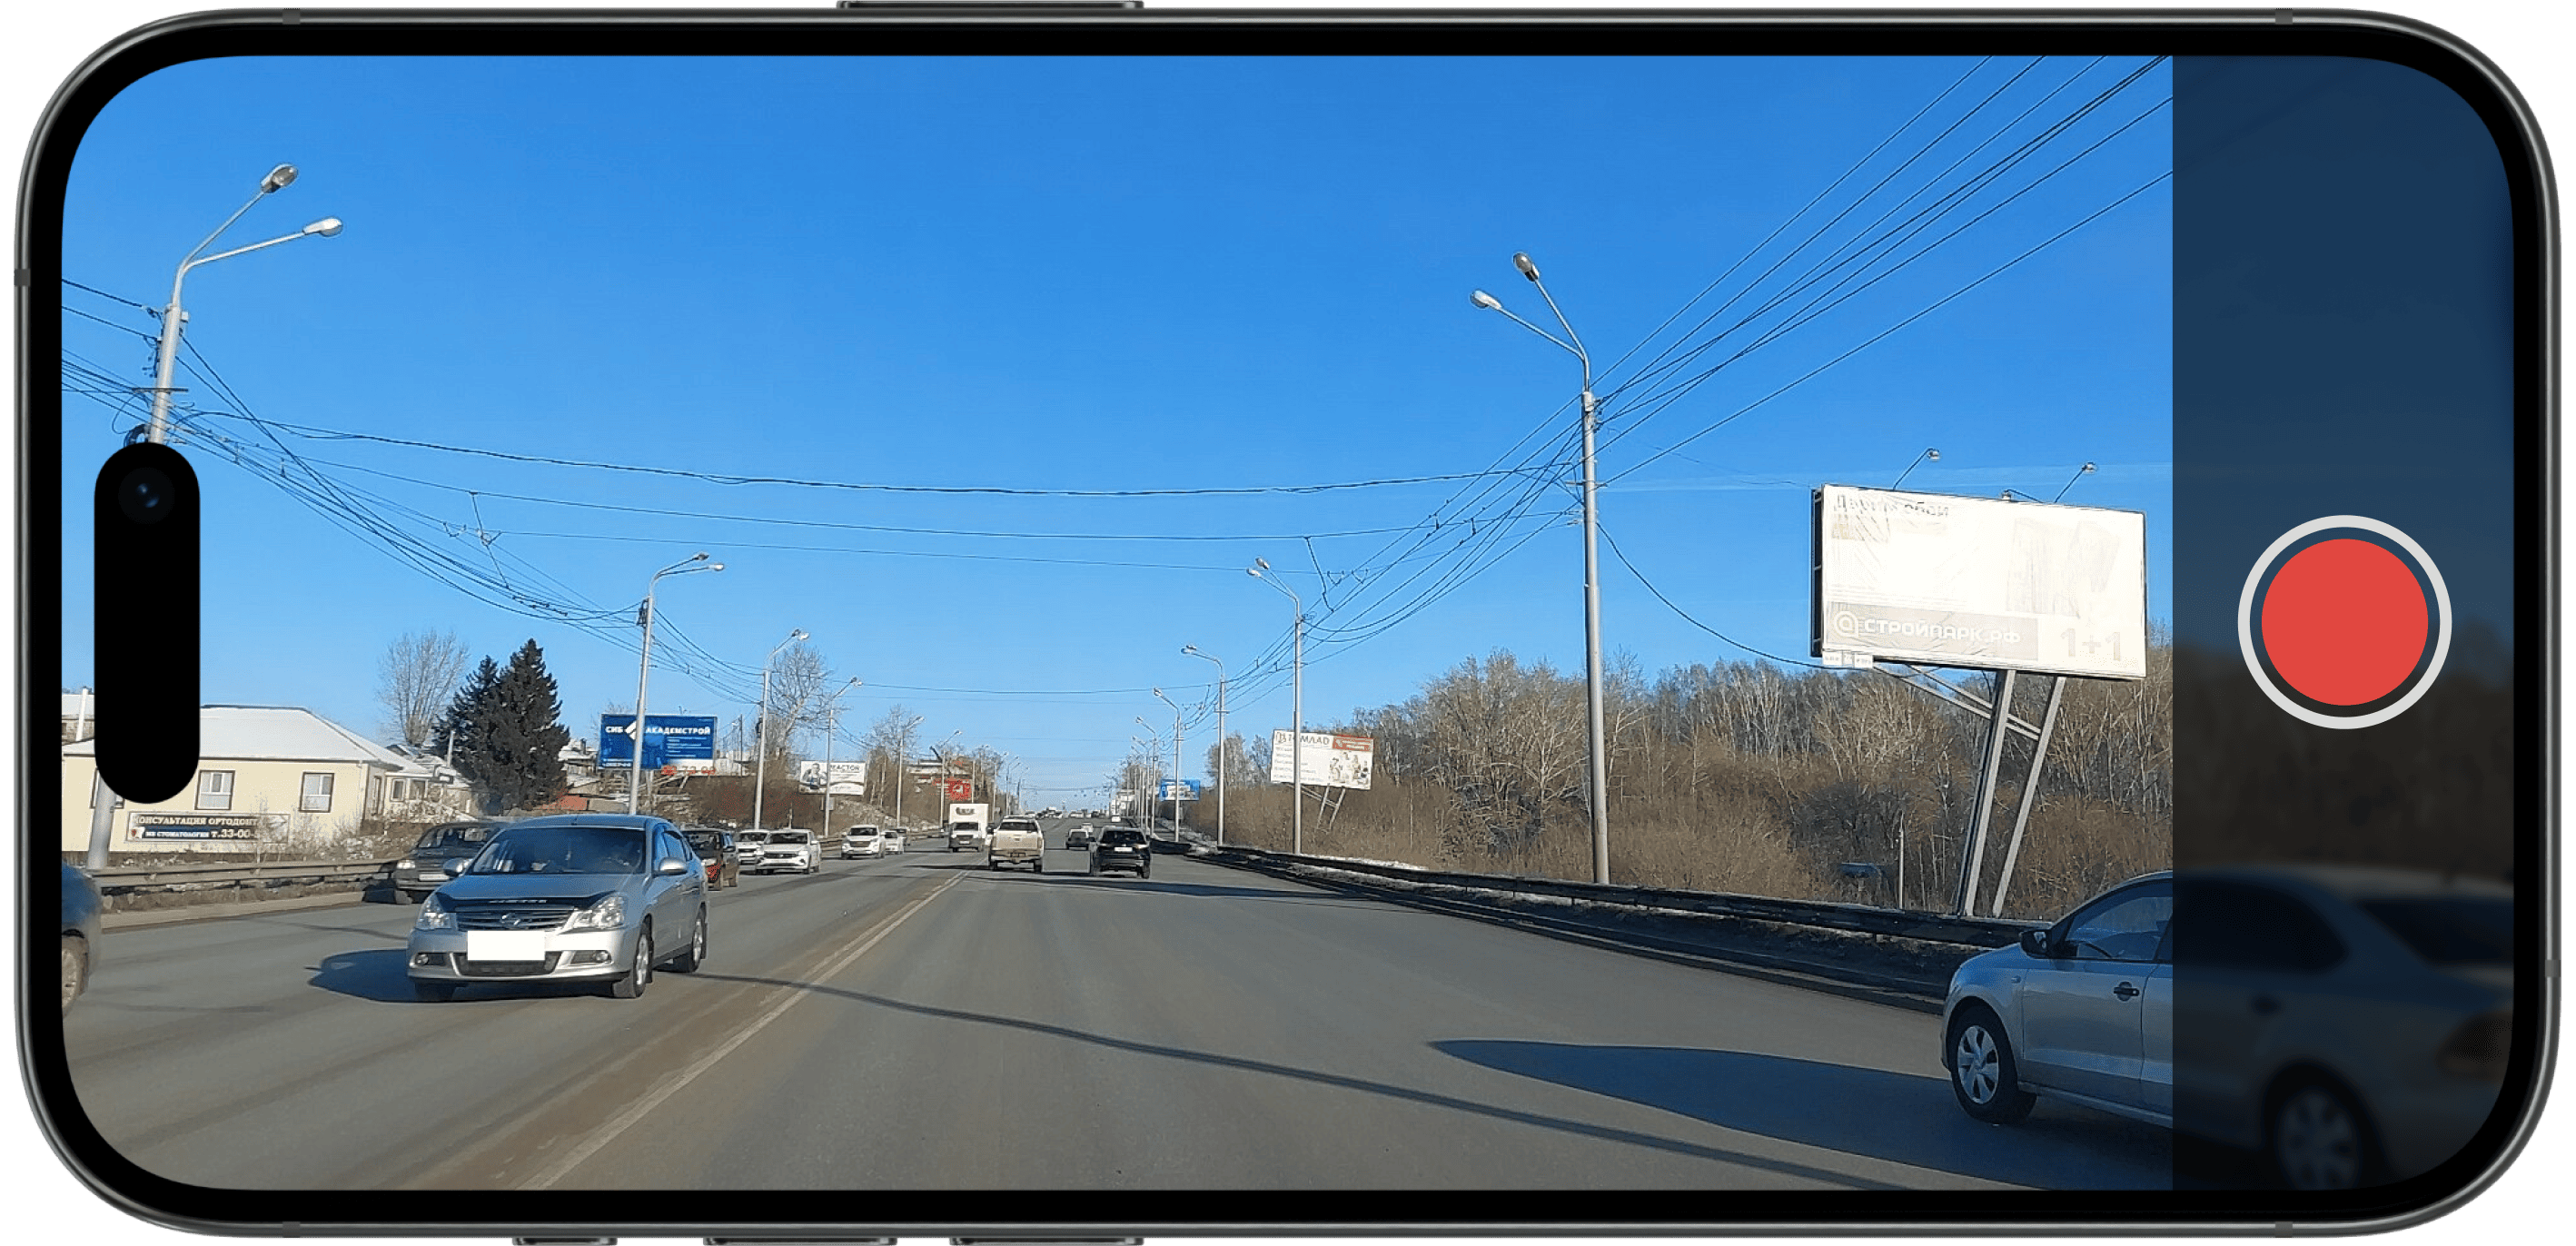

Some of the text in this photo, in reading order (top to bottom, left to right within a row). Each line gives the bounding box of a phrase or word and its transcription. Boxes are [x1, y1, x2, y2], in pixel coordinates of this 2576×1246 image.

[1864, 618, 2021, 644] СТРОЙПАРК.РФ
[2060, 628, 2122, 662] 1+1
[605, 726, 623, 734] СИБ
